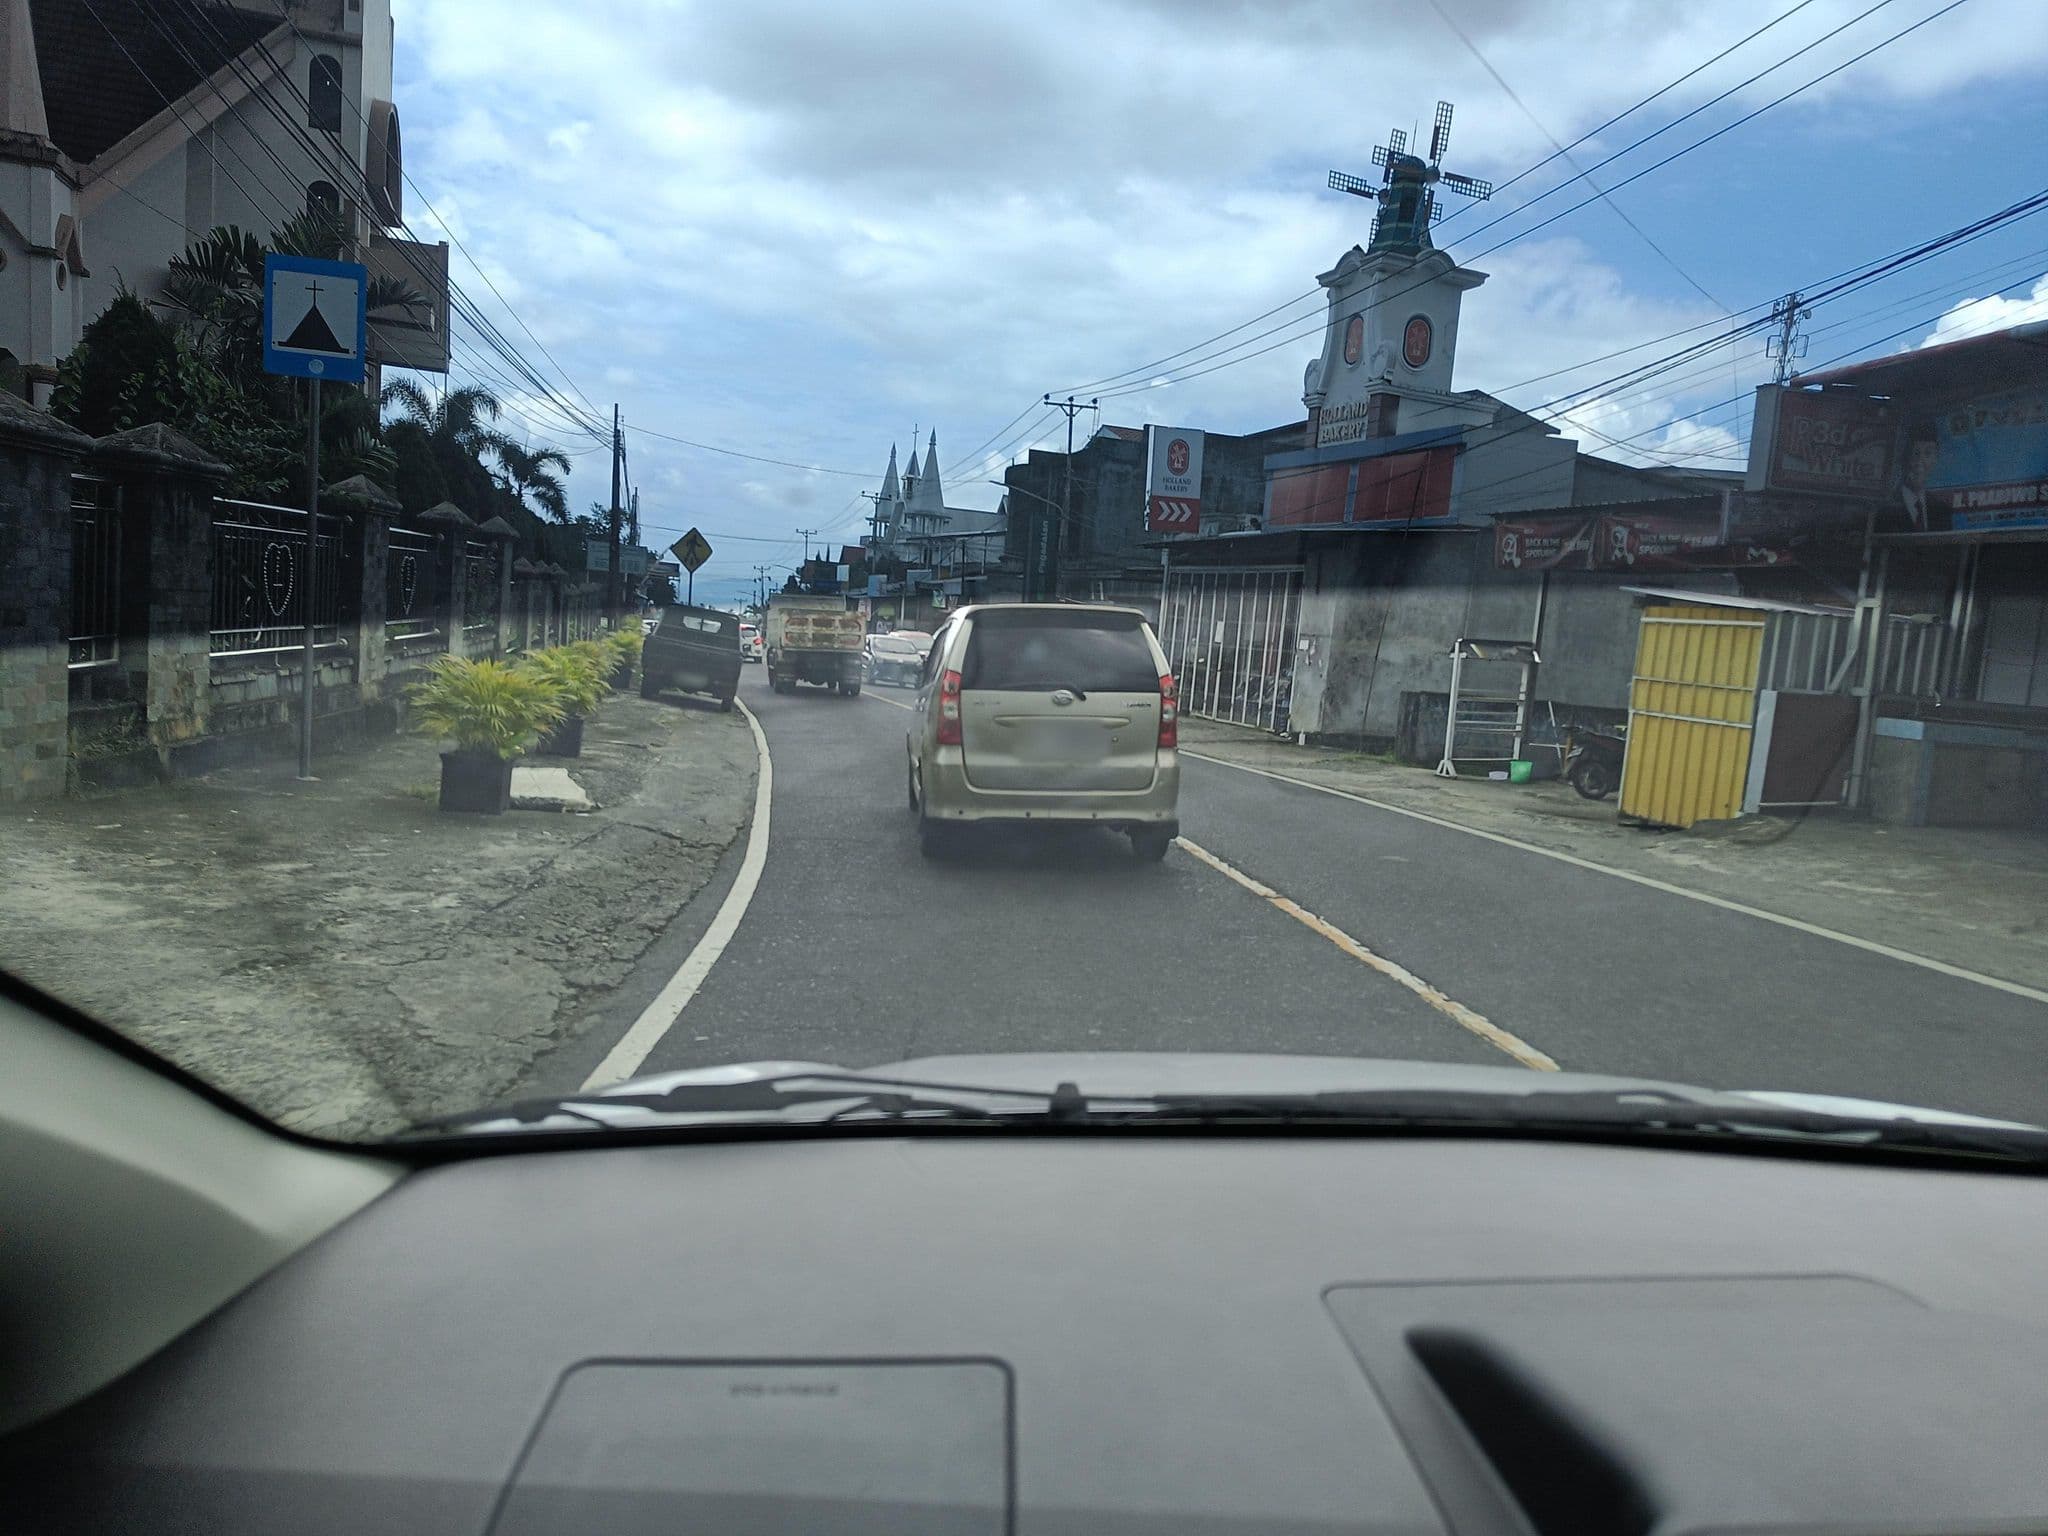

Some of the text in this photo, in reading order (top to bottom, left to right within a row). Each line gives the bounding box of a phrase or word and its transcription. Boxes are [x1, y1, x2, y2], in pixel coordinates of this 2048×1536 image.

[1320, 402, 1368, 425] HOLLAND
[1320, 422, 1367, 443] BAKERY
[1163, 476, 1192, 485] HOLLAND
